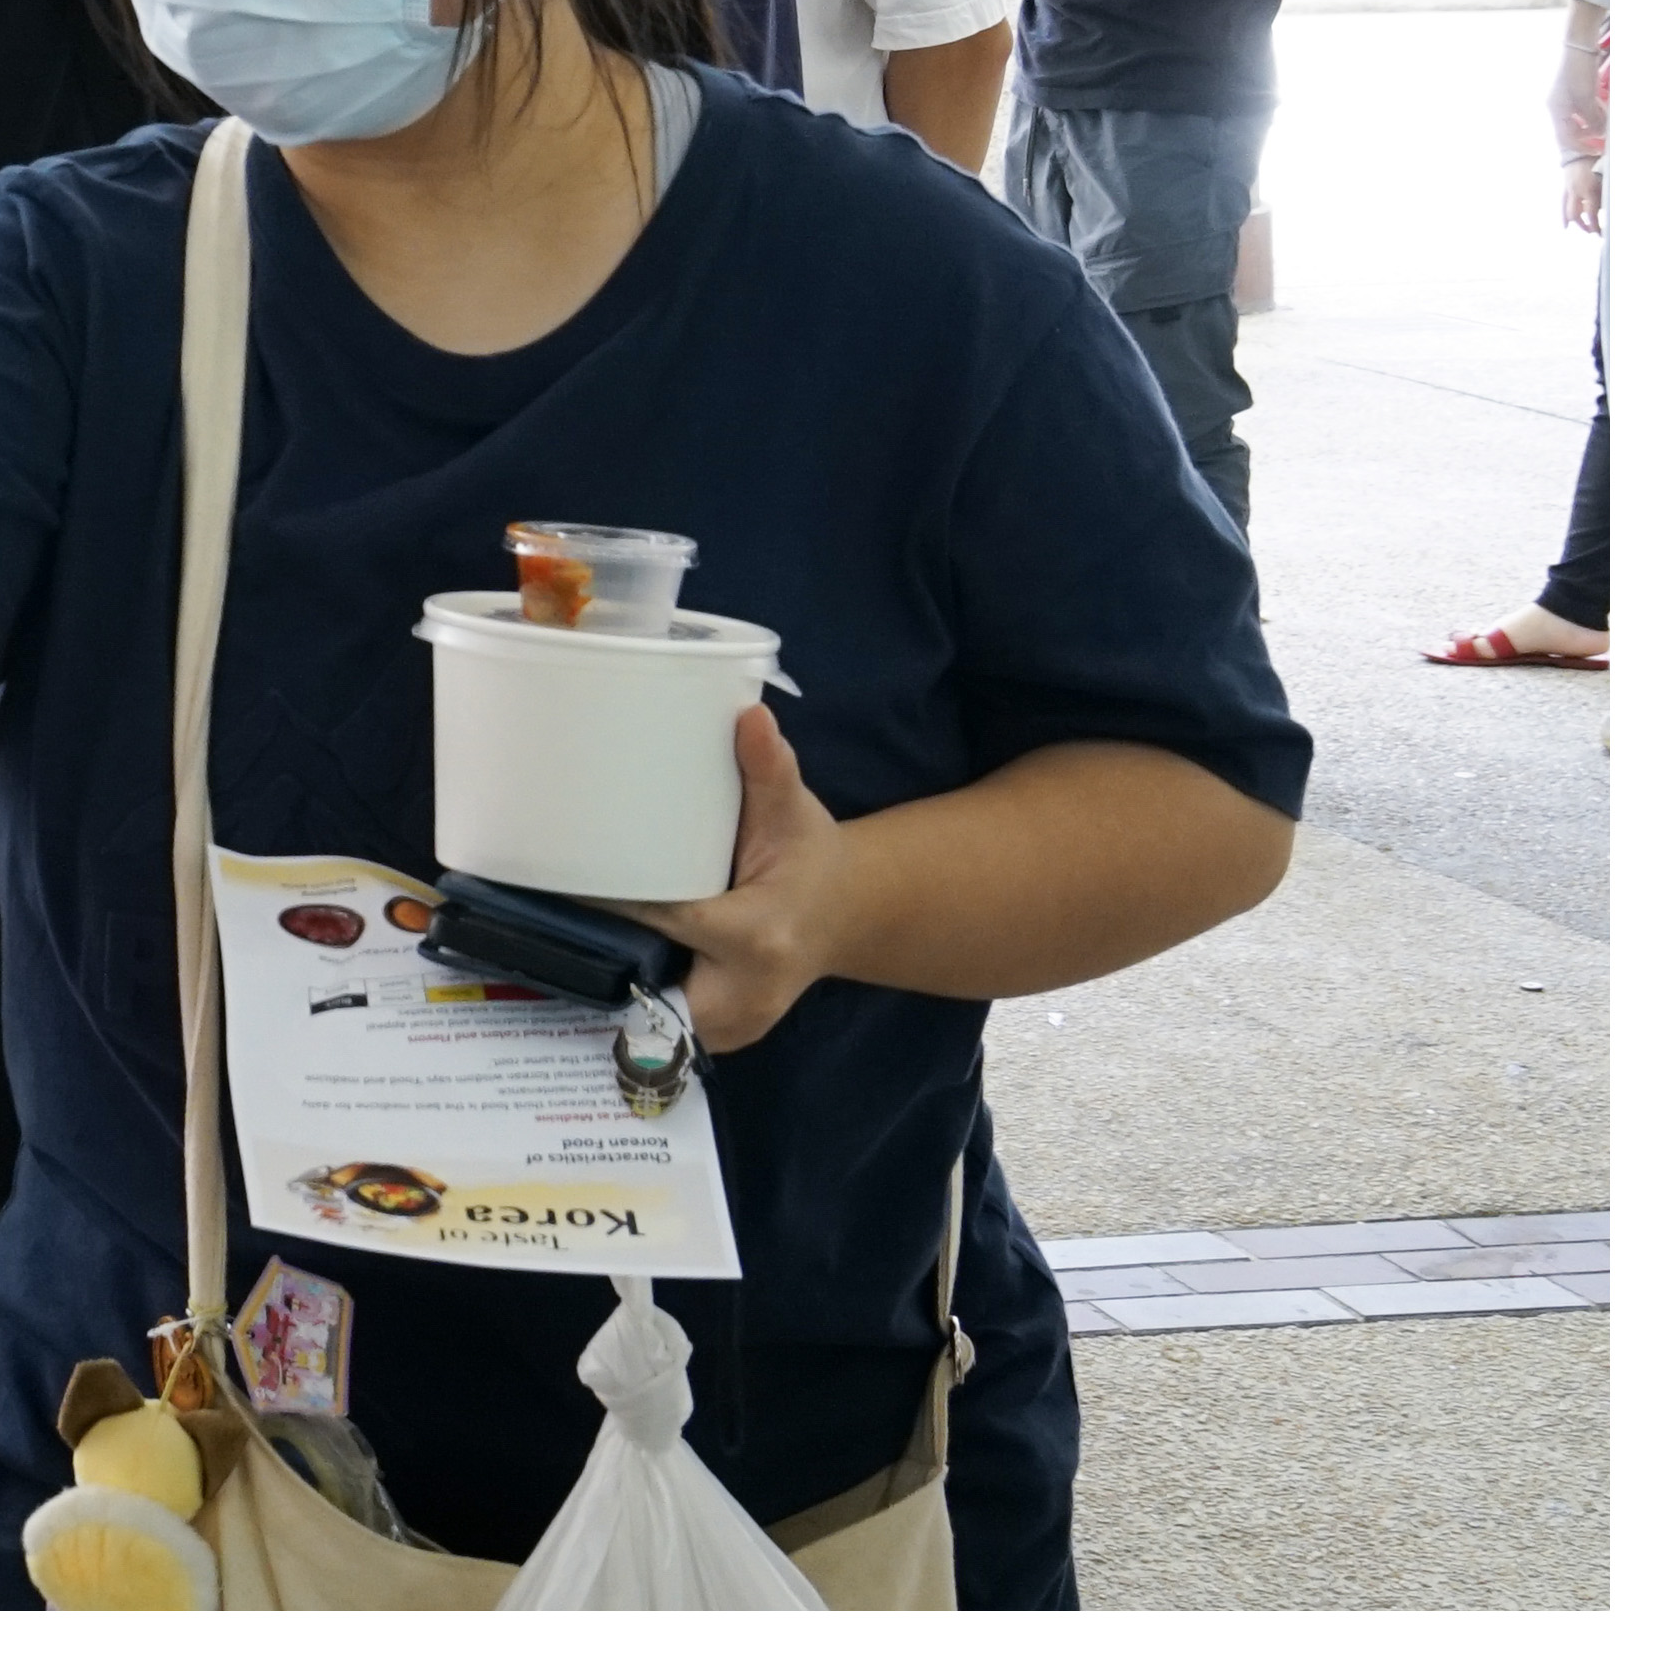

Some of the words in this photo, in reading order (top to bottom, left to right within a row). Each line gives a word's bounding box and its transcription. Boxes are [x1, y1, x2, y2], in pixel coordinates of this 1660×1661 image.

[583, 1053, 612, 1064] hare
[562, 1137, 604, 1151] Food
[608, 1136, 670, 1149] Korean
[526, 1153, 543, 1166] of
[547, 1151, 672, 1166] Characteristics
[465, 1205, 646, 1237] Korea
[439, 1228, 469, 1243] of
[481, 1231, 569, 1251] Taste
